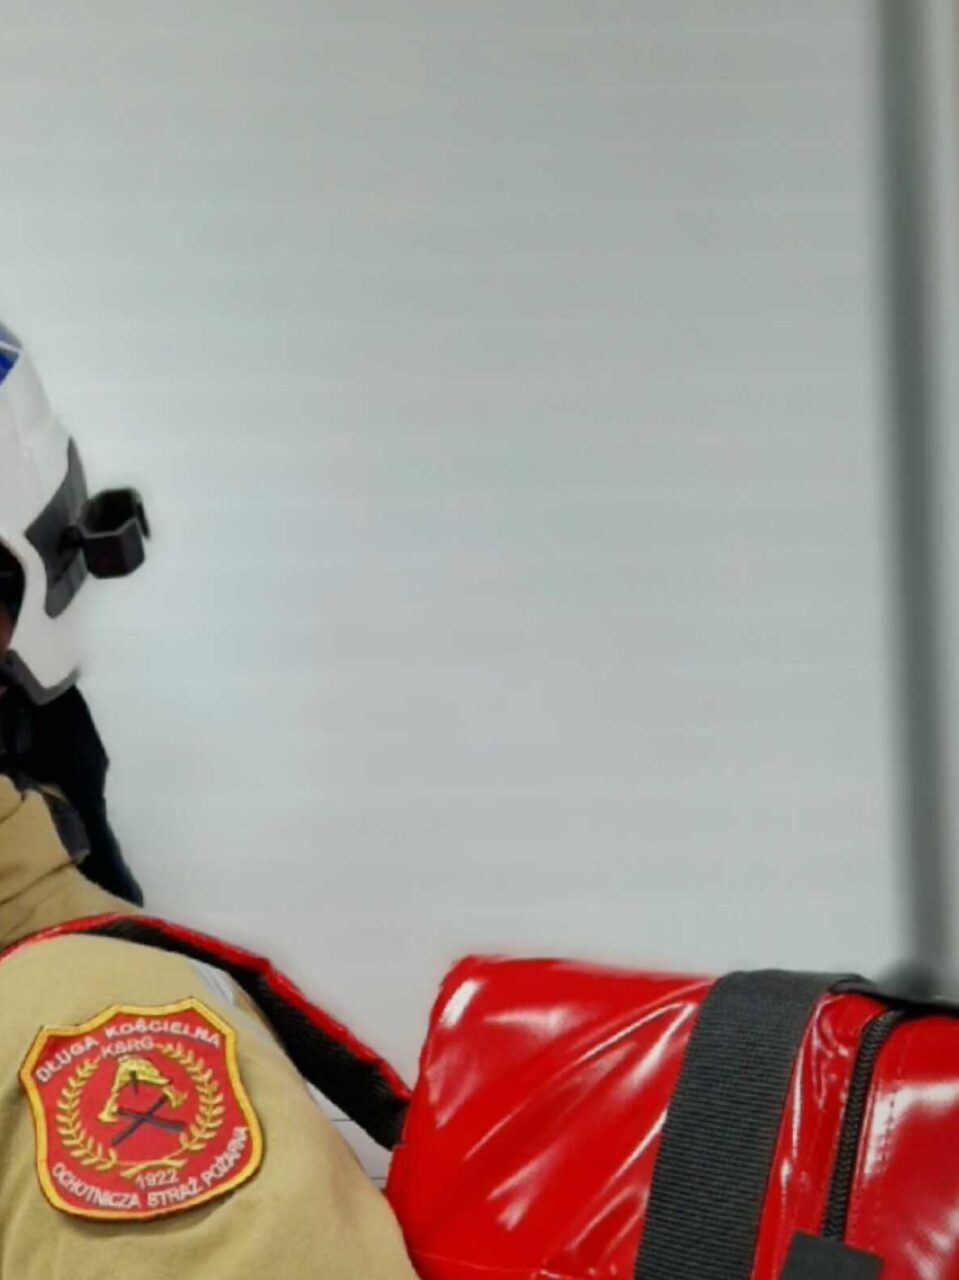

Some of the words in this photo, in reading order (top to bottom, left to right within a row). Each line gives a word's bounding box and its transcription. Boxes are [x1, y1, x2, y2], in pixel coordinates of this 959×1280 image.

[35, 1037, 99, 1083] DŁUGA
[105, 1018, 220, 1048] KOŚCIELNA
[101, 1037, 154, 1059] KSRG
[52, 1163, 140, 1208] OCHOTNICZA
[135, 1169, 179, 1190] 1922
